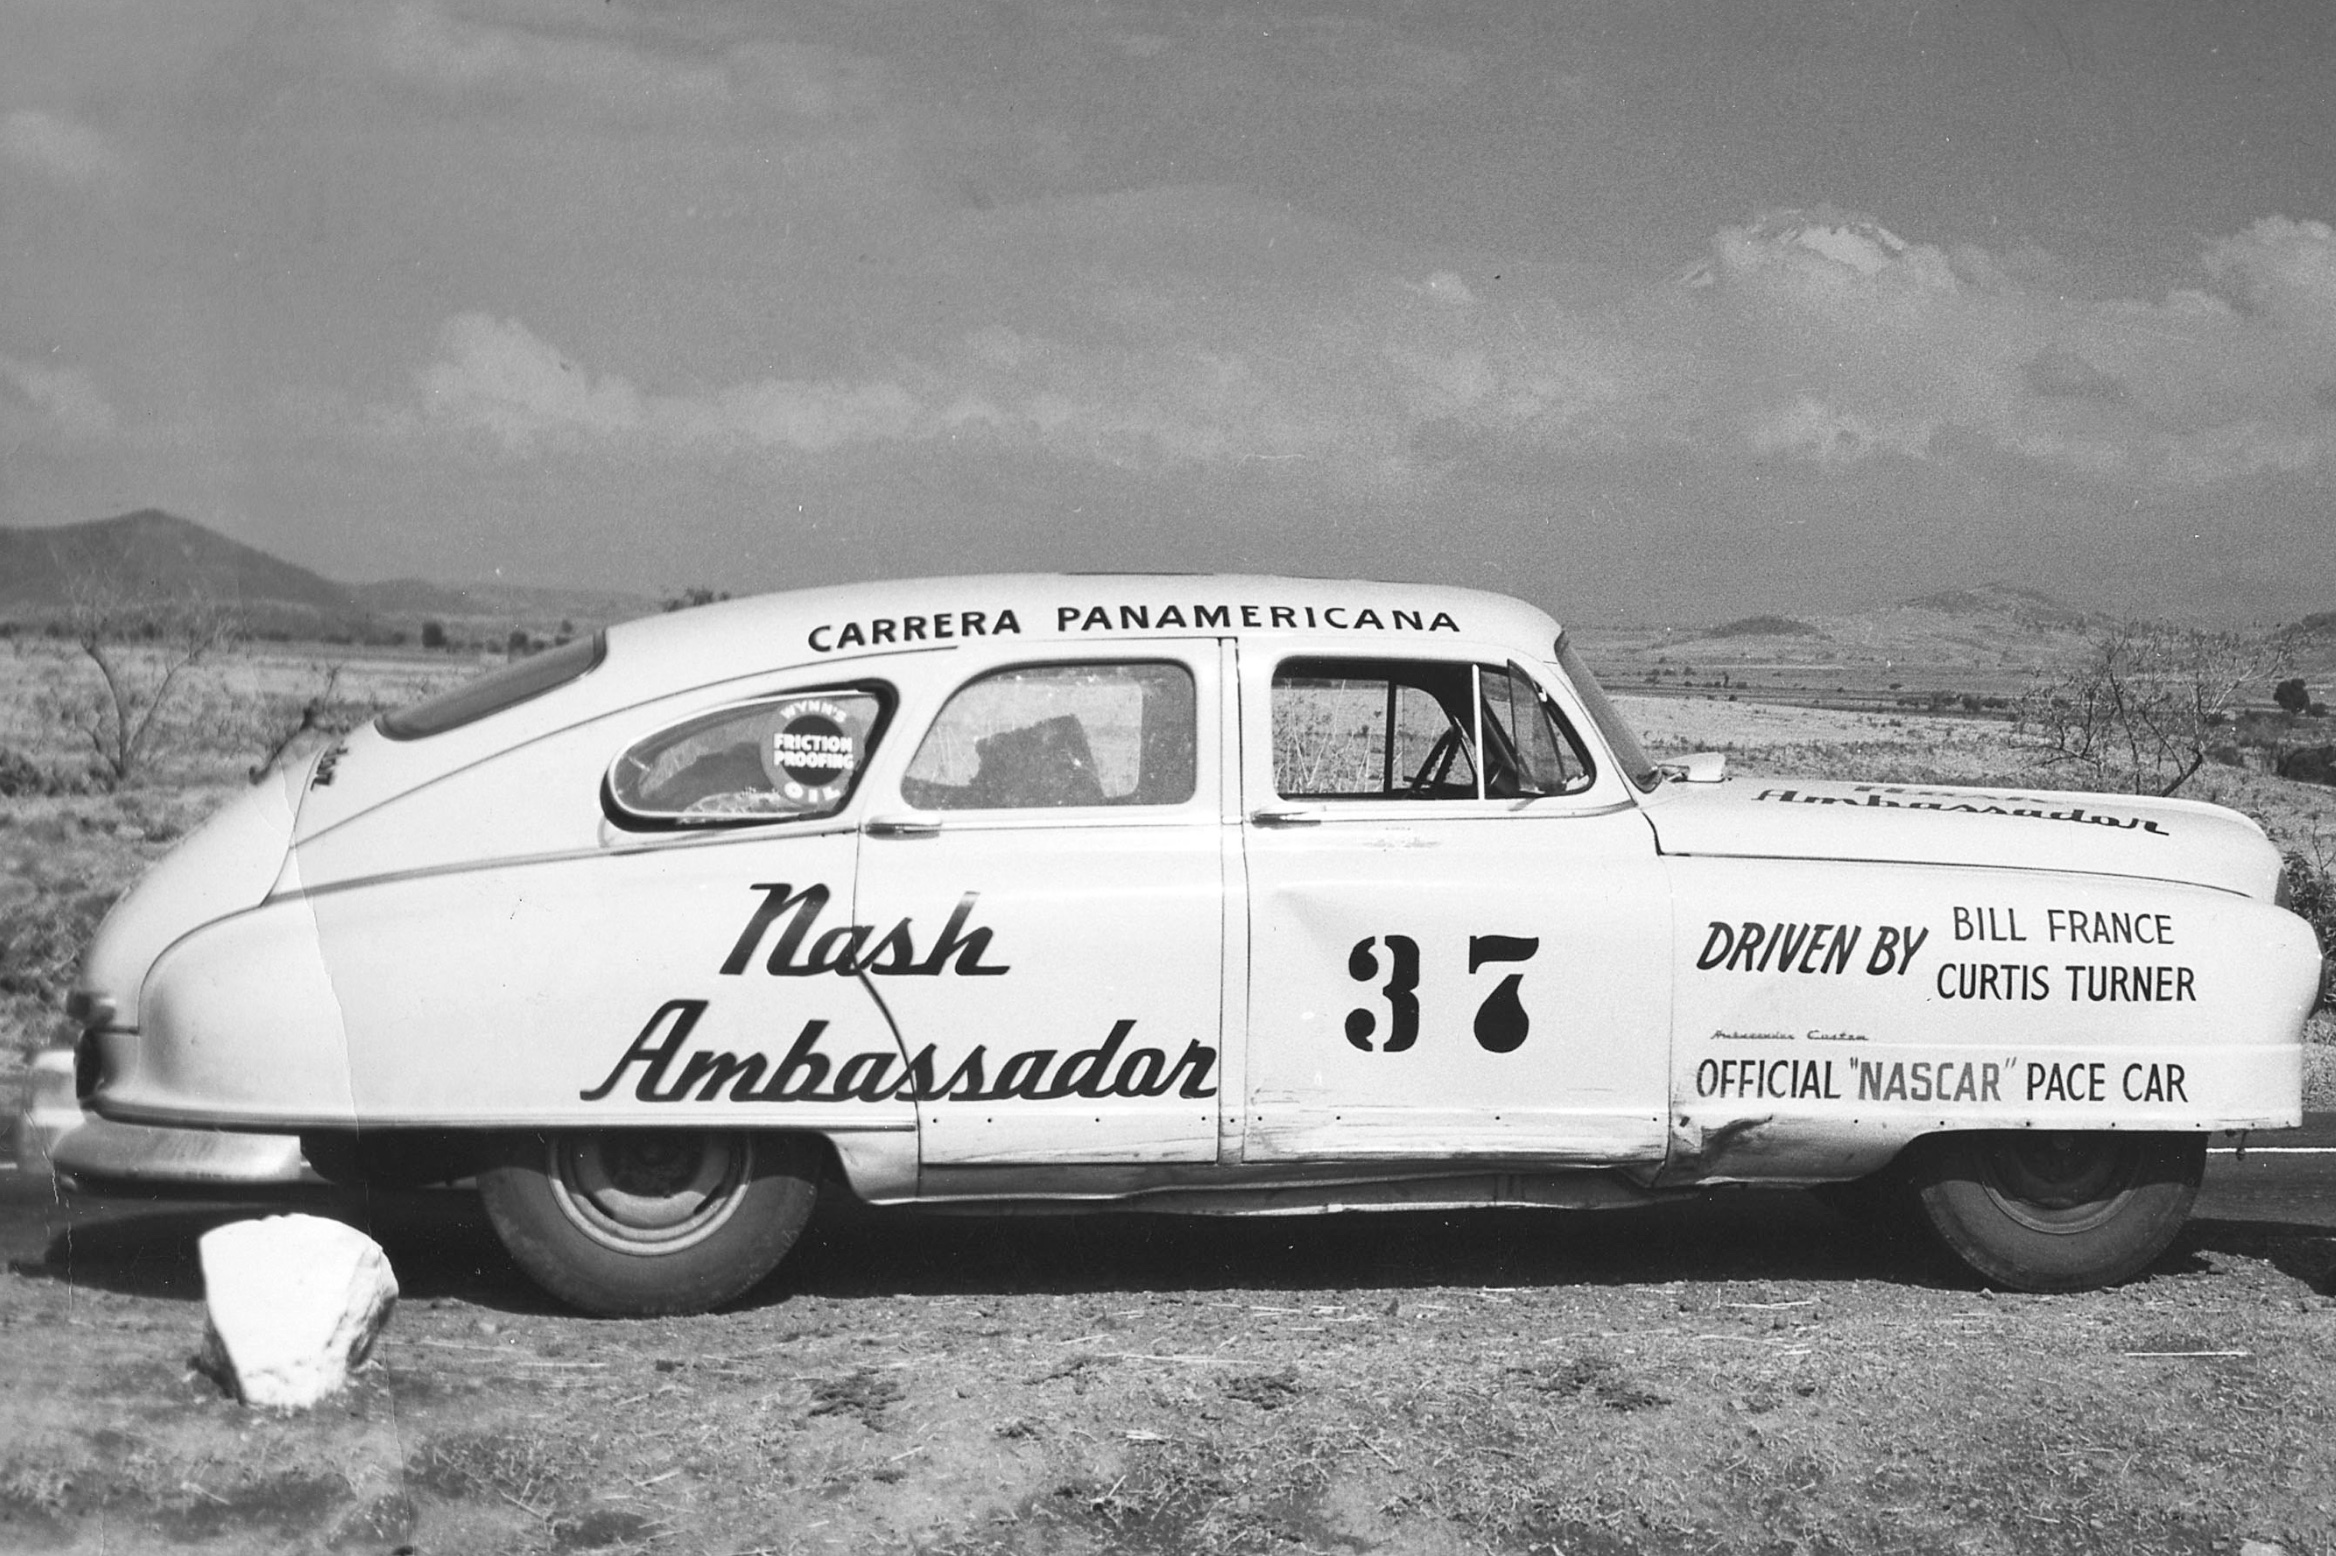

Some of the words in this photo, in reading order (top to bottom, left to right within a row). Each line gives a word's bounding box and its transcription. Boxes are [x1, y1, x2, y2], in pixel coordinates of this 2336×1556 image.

[807, 609, 1021, 652] CARRERA
[1057, 604, 1460, 633] PANAMERICANA
[780, 700, 847, 723] WYNN'S
[773, 733, 853, 753] FRICTION
[773, 750, 854, 770] PROOFING
[784, 781, 841, 803] OIL
[1750, 787, 2170, 837] Ambassador
[718, 883, 1011, 977] Nash
[1952, 906, 2028, 942] BILL
[2047, 909, 2176, 945] FRANCE
[1696, 921, 1861, 975] DRIVEN
[1866, 926, 1930, 976] BY
[1344, 934, 1540, 1054] 37
[1936, 963, 2050, 1001] CURTIS
[2065, 965, 2197, 1002] TURNER
[579, 999, 1217, 1102] Ambassador
[1697, 1058, 1841, 1099] OFFICIAL
[2027, 1062, 2106, 1102] PACE
[2122, 1062, 2188, 1103] CAR
